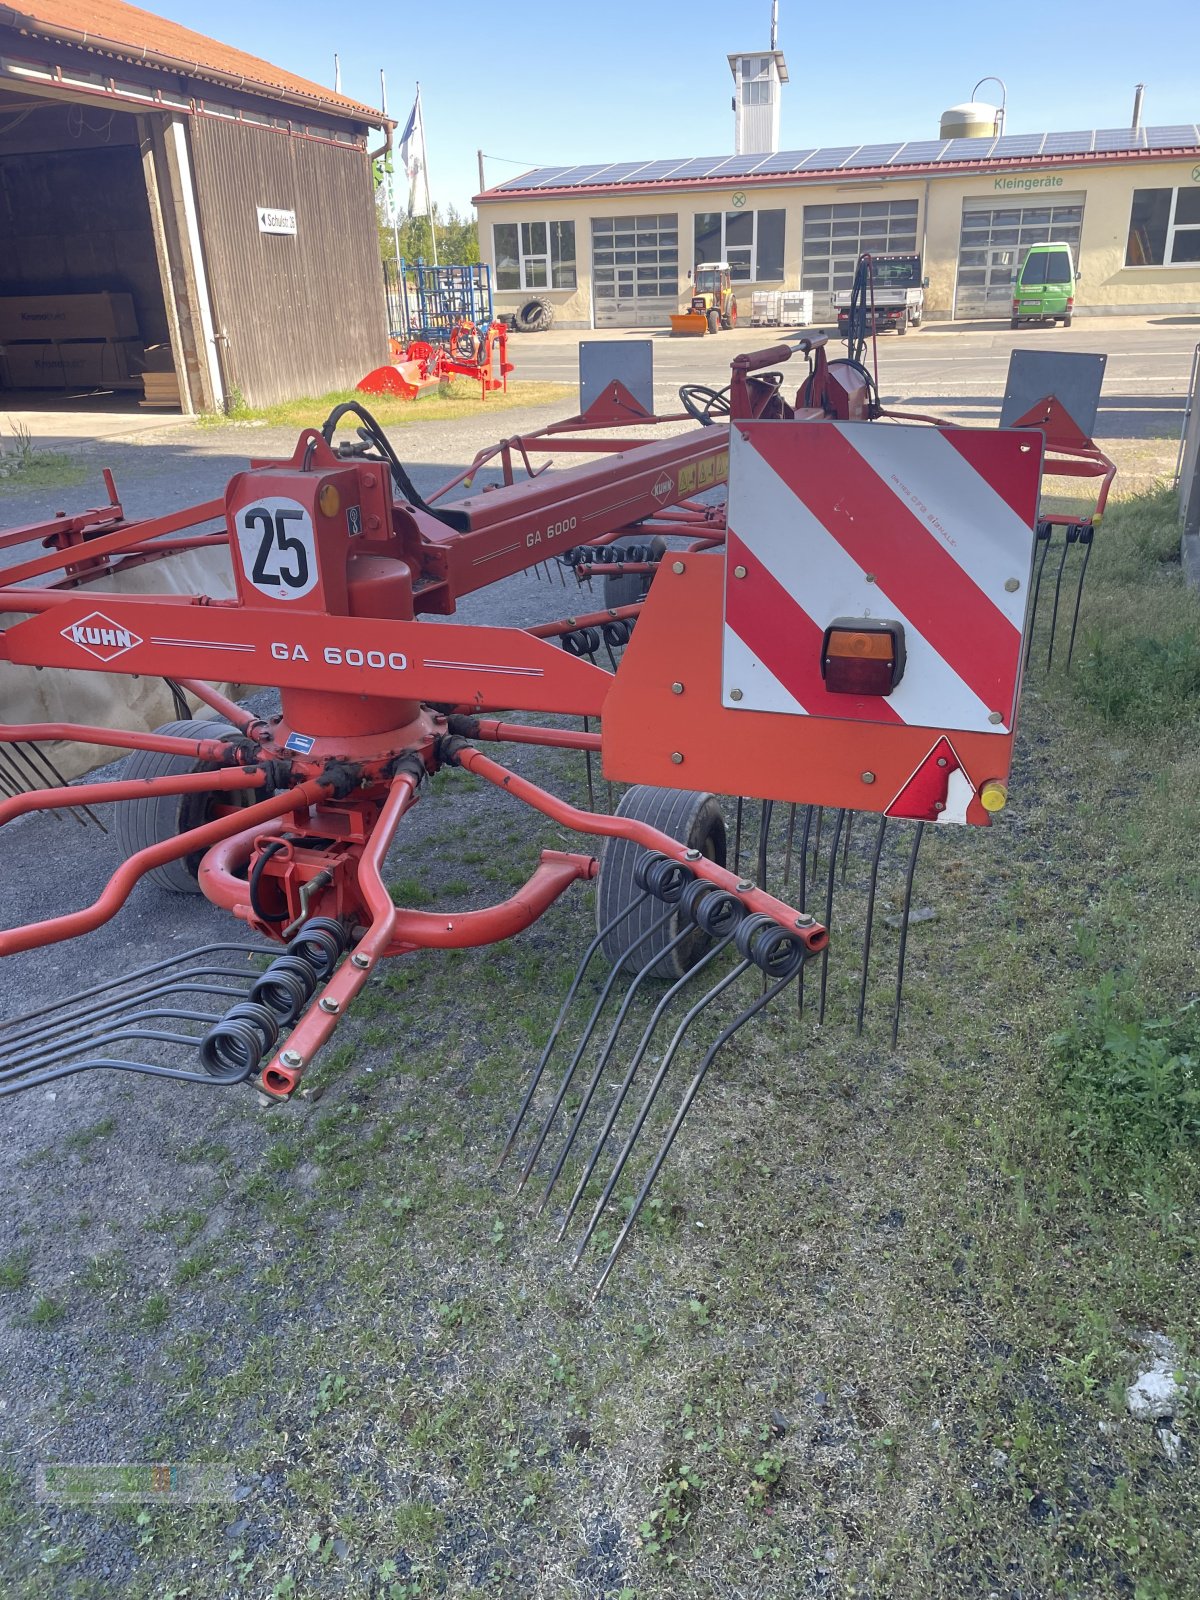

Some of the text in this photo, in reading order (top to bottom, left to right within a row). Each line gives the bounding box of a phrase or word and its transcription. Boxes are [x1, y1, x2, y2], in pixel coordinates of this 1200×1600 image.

[994, 175, 1063, 191] Kleingeräte
[653, 480, 673, 497] KUHN
[526, 516, 577, 548] GA 6000
[244, 507, 309, 588] 25
[71, 625, 132, 648] KUHN
[270, 642, 407, 671] GA 6000
